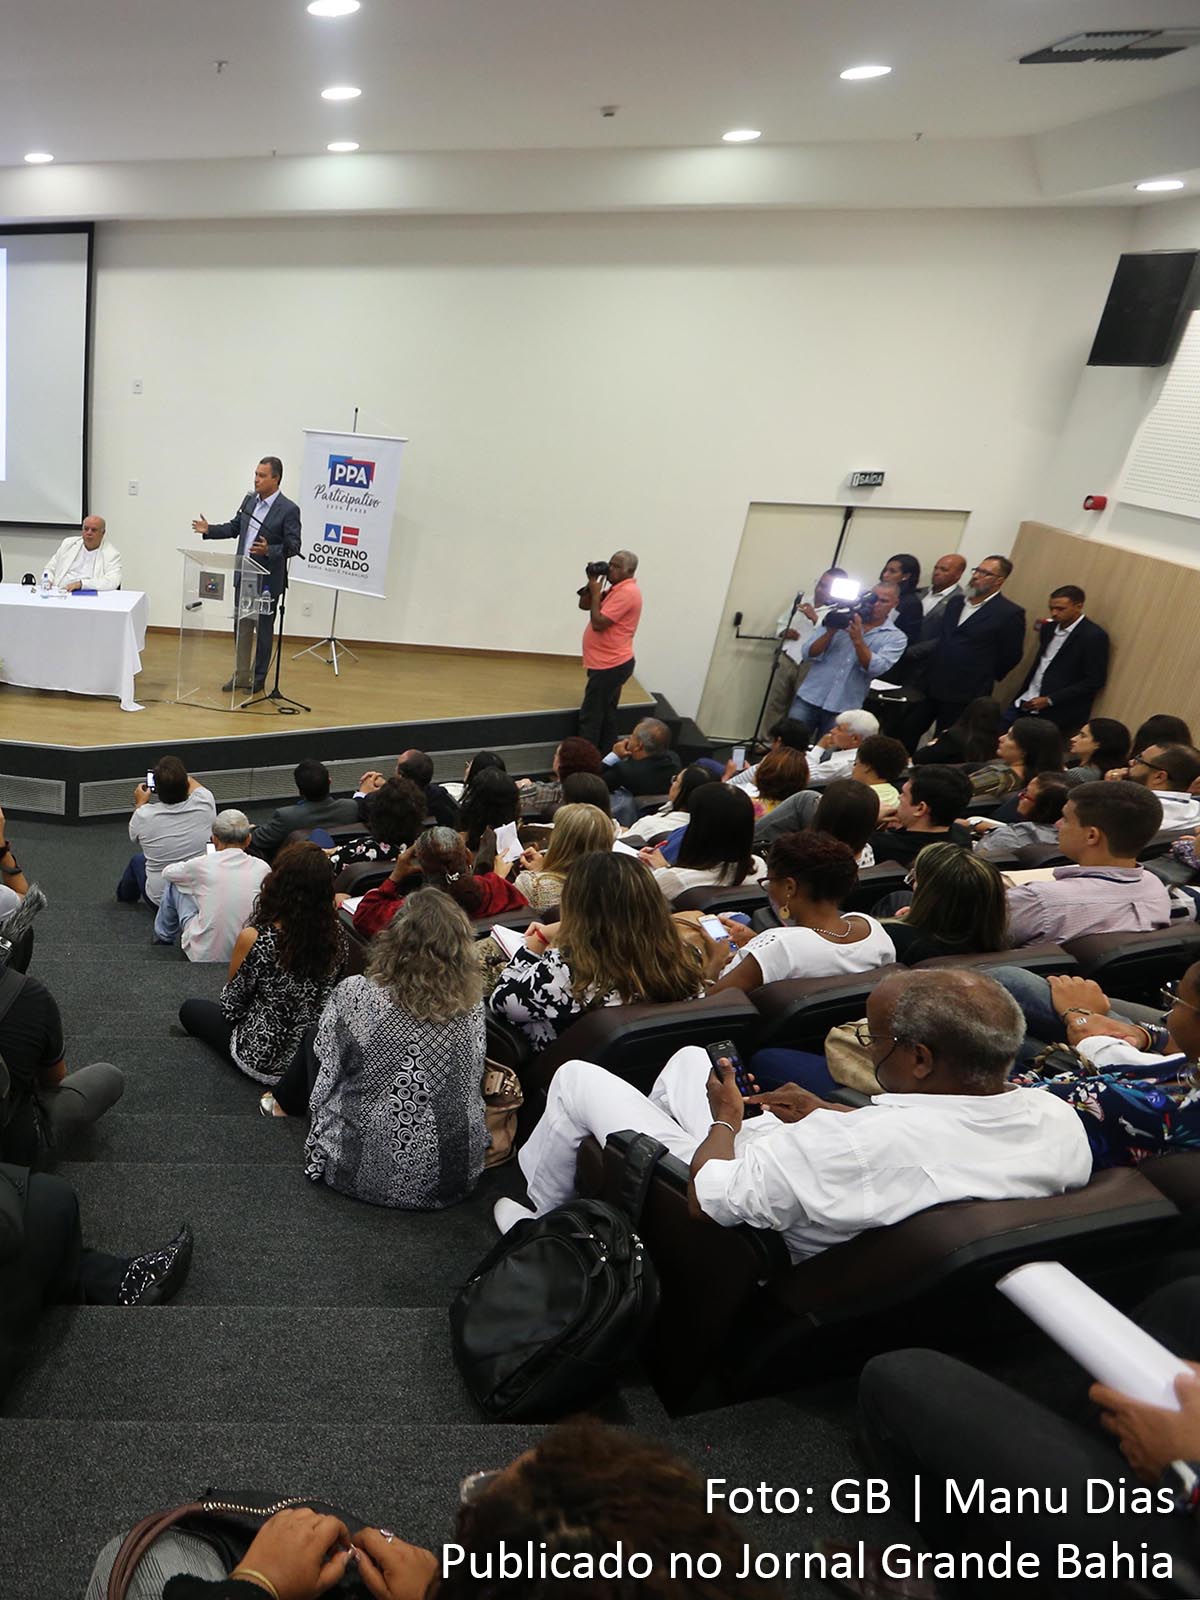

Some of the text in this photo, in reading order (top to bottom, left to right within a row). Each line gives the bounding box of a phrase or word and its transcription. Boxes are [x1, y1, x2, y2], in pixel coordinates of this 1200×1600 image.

[335, 463, 368, 485] PPA
[314, 483, 382, 511] Participativo
[313, 542, 368, 561] GOVERNO
[308, 553, 370, 573] DO ESTADO
